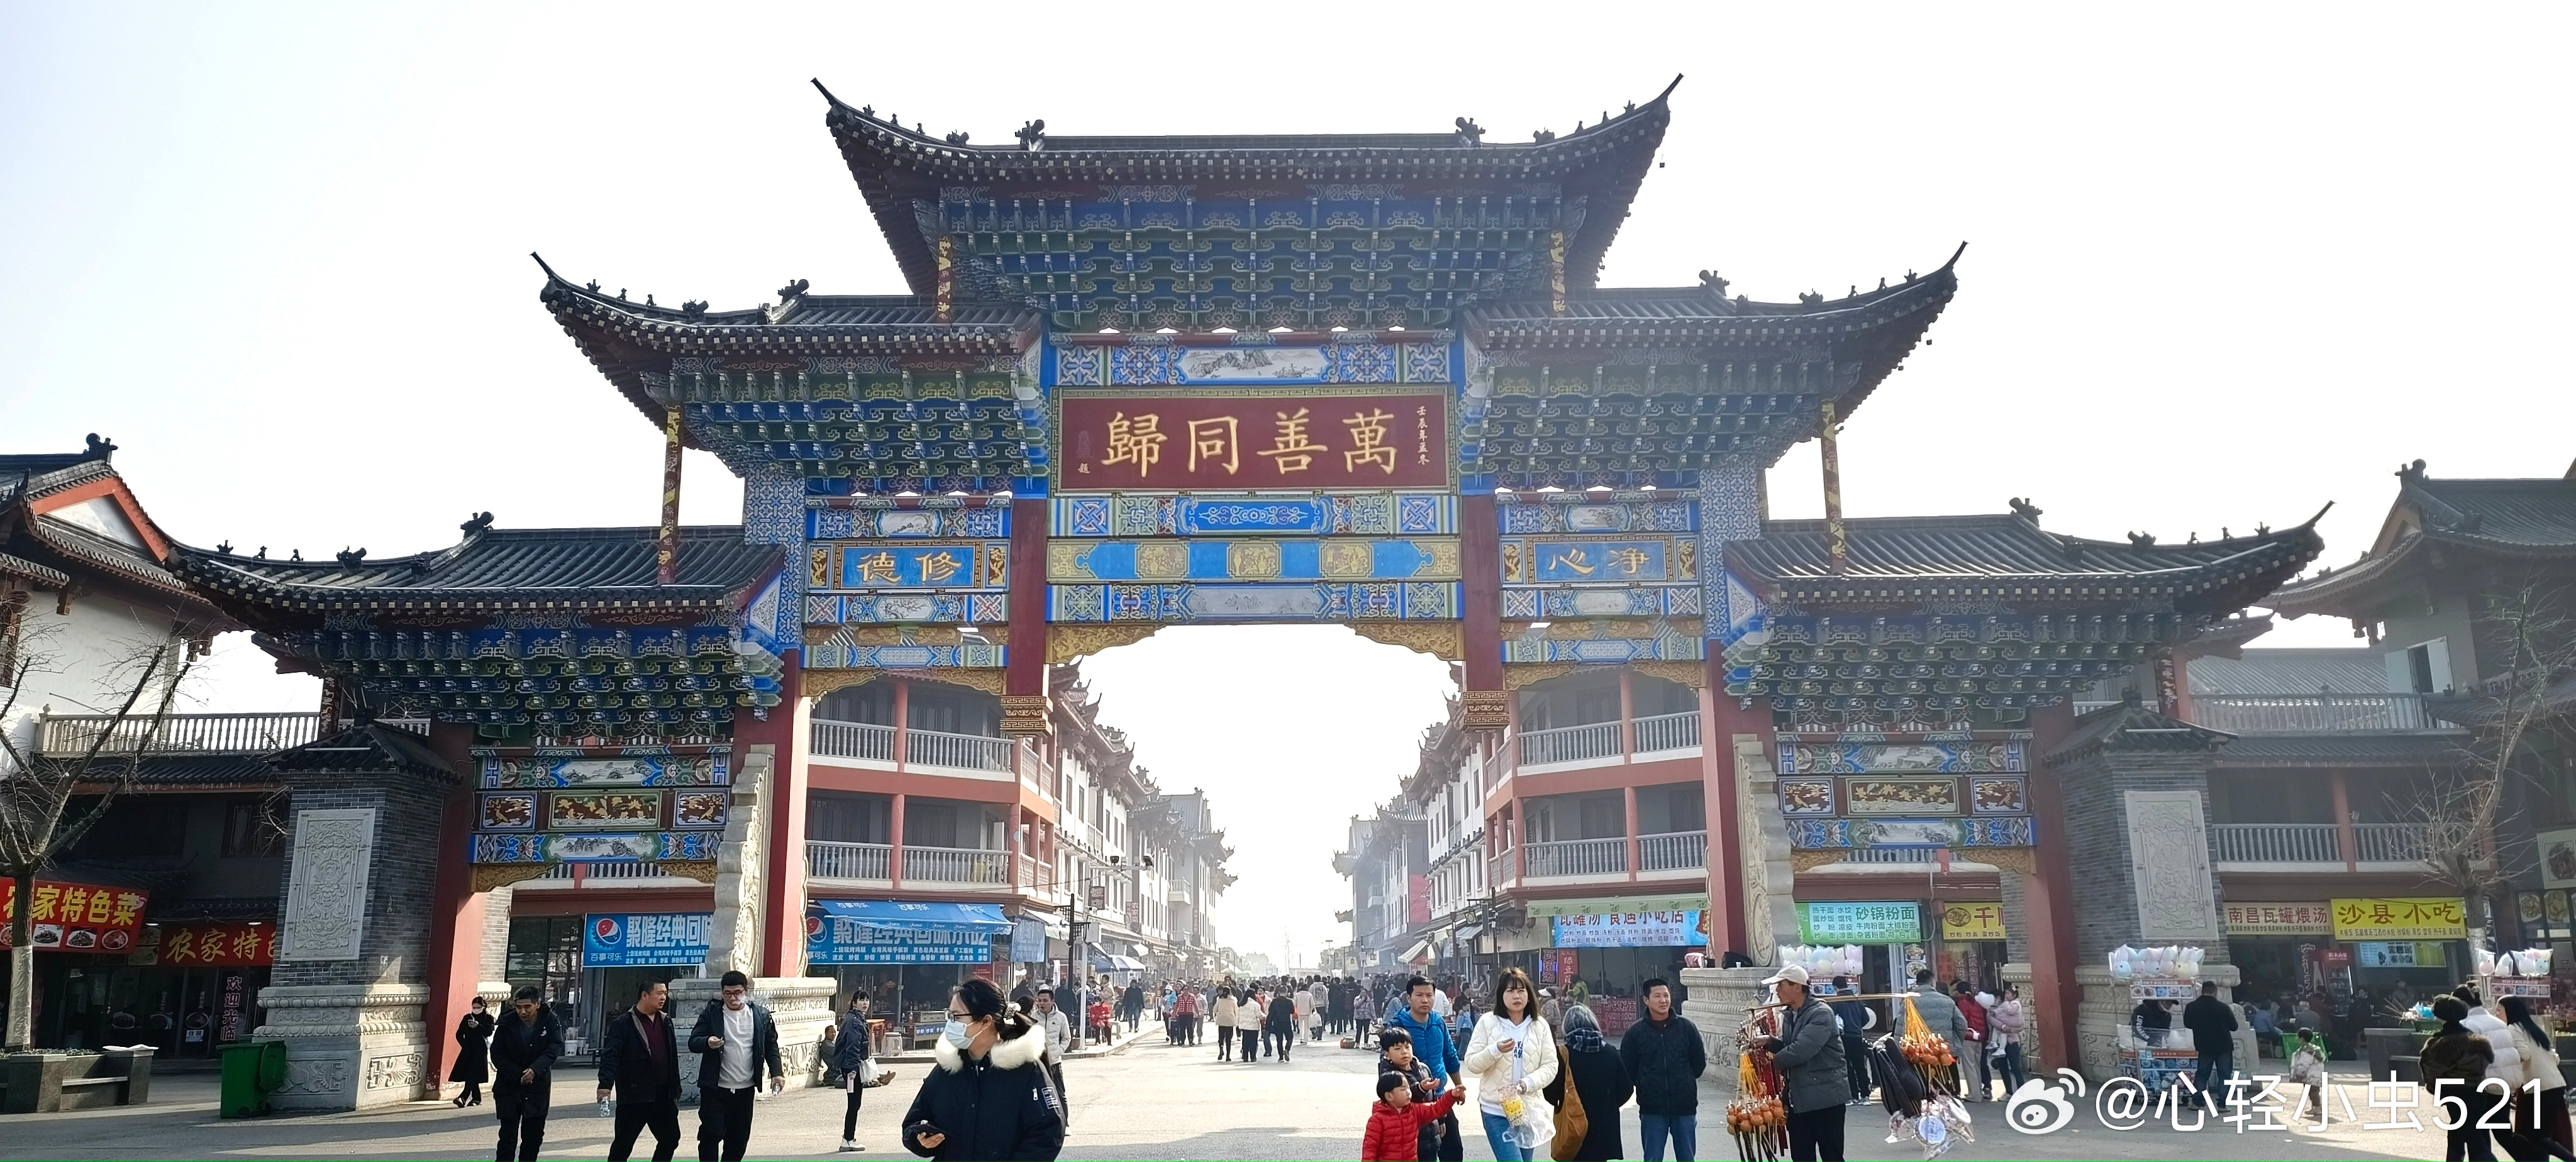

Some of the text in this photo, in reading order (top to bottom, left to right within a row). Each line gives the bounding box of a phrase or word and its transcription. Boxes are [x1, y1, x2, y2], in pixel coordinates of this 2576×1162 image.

[857, 551, 962, 584] 修德
[1856, 906, 1914, 921] 砂锅粉面
[2228, 907, 2327, 924] 南昌瓦罐煨汤
[2338, 902, 2461, 924] 沙县小吃
[590, 953, 623, 961] 百事可乐
[808, 951, 828, 960] 事可乐
[221, 976, 243, 1041] 欢迎光临
